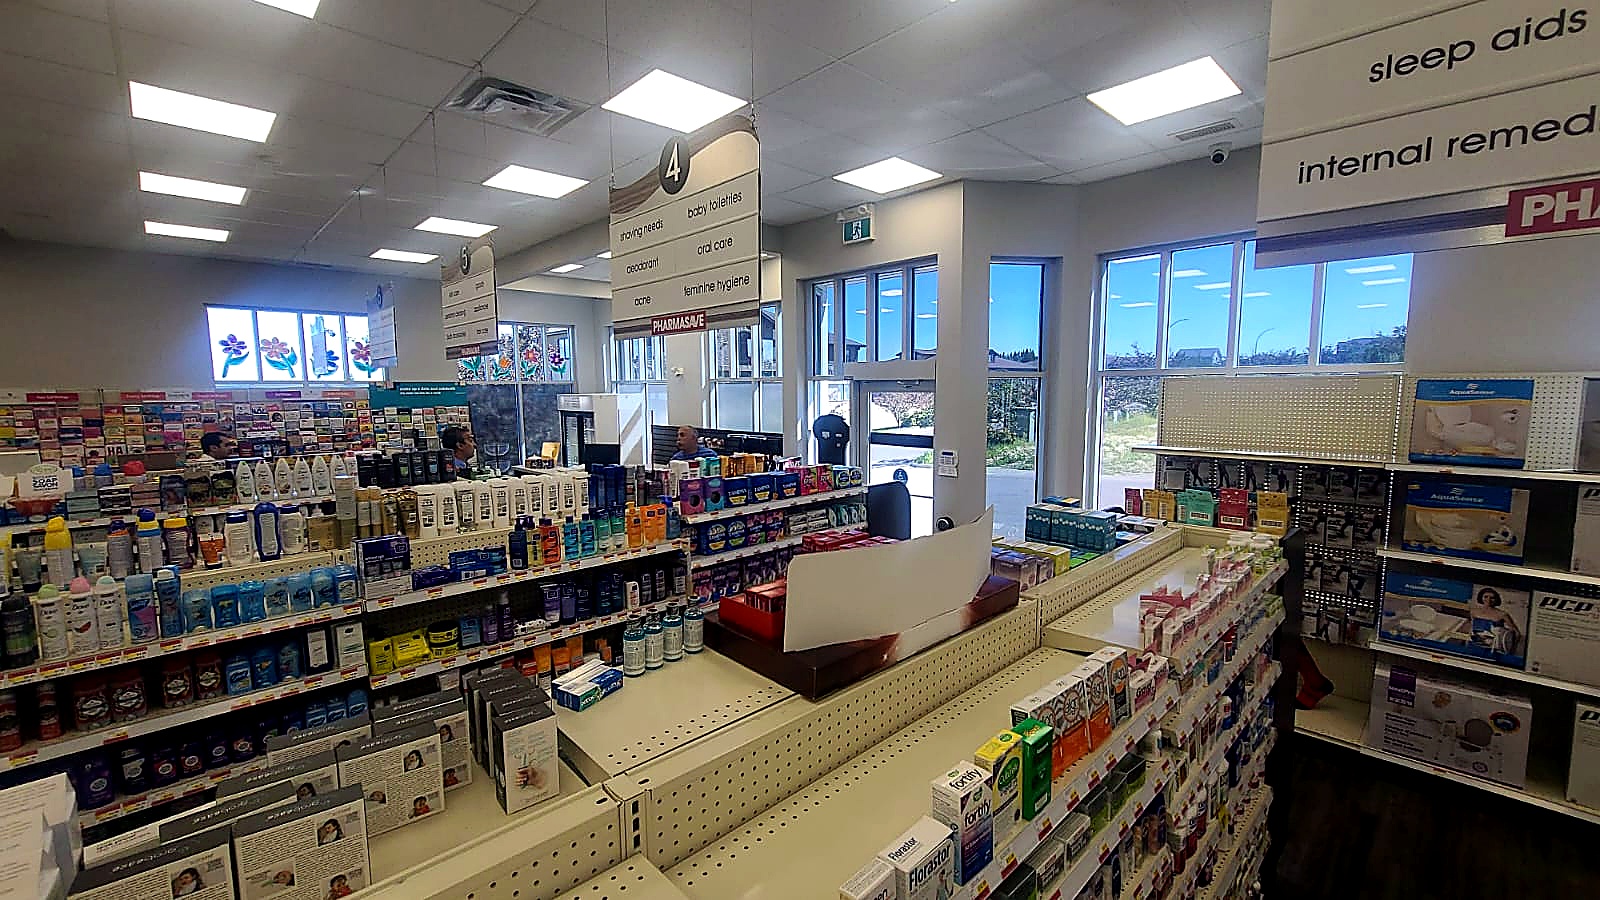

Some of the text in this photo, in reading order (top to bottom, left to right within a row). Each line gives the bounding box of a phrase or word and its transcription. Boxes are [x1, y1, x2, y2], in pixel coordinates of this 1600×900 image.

[1368, 8, 1587, 83] sleep aids
[1297, 104, 1600, 185] internal remed
[665, 142, 681, 182] 4
[687, 191, 743, 219] baby toiletries
[1520, 187, 1600, 227] PH
[620, 219, 664, 243] shaving needs
[697, 236, 733, 256] oral care
[626, 258, 659, 275] deodorant
[683, 274, 750, 297] feminine hygiene
[634, 294, 651, 306] acne
[653, 313, 705, 333] PHARMASAVE
[949, 769, 982, 790] fortify
[965, 800, 991, 828] fortify
[888, 837, 918, 860] Florastor
[909, 845, 951, 891] Florastor
